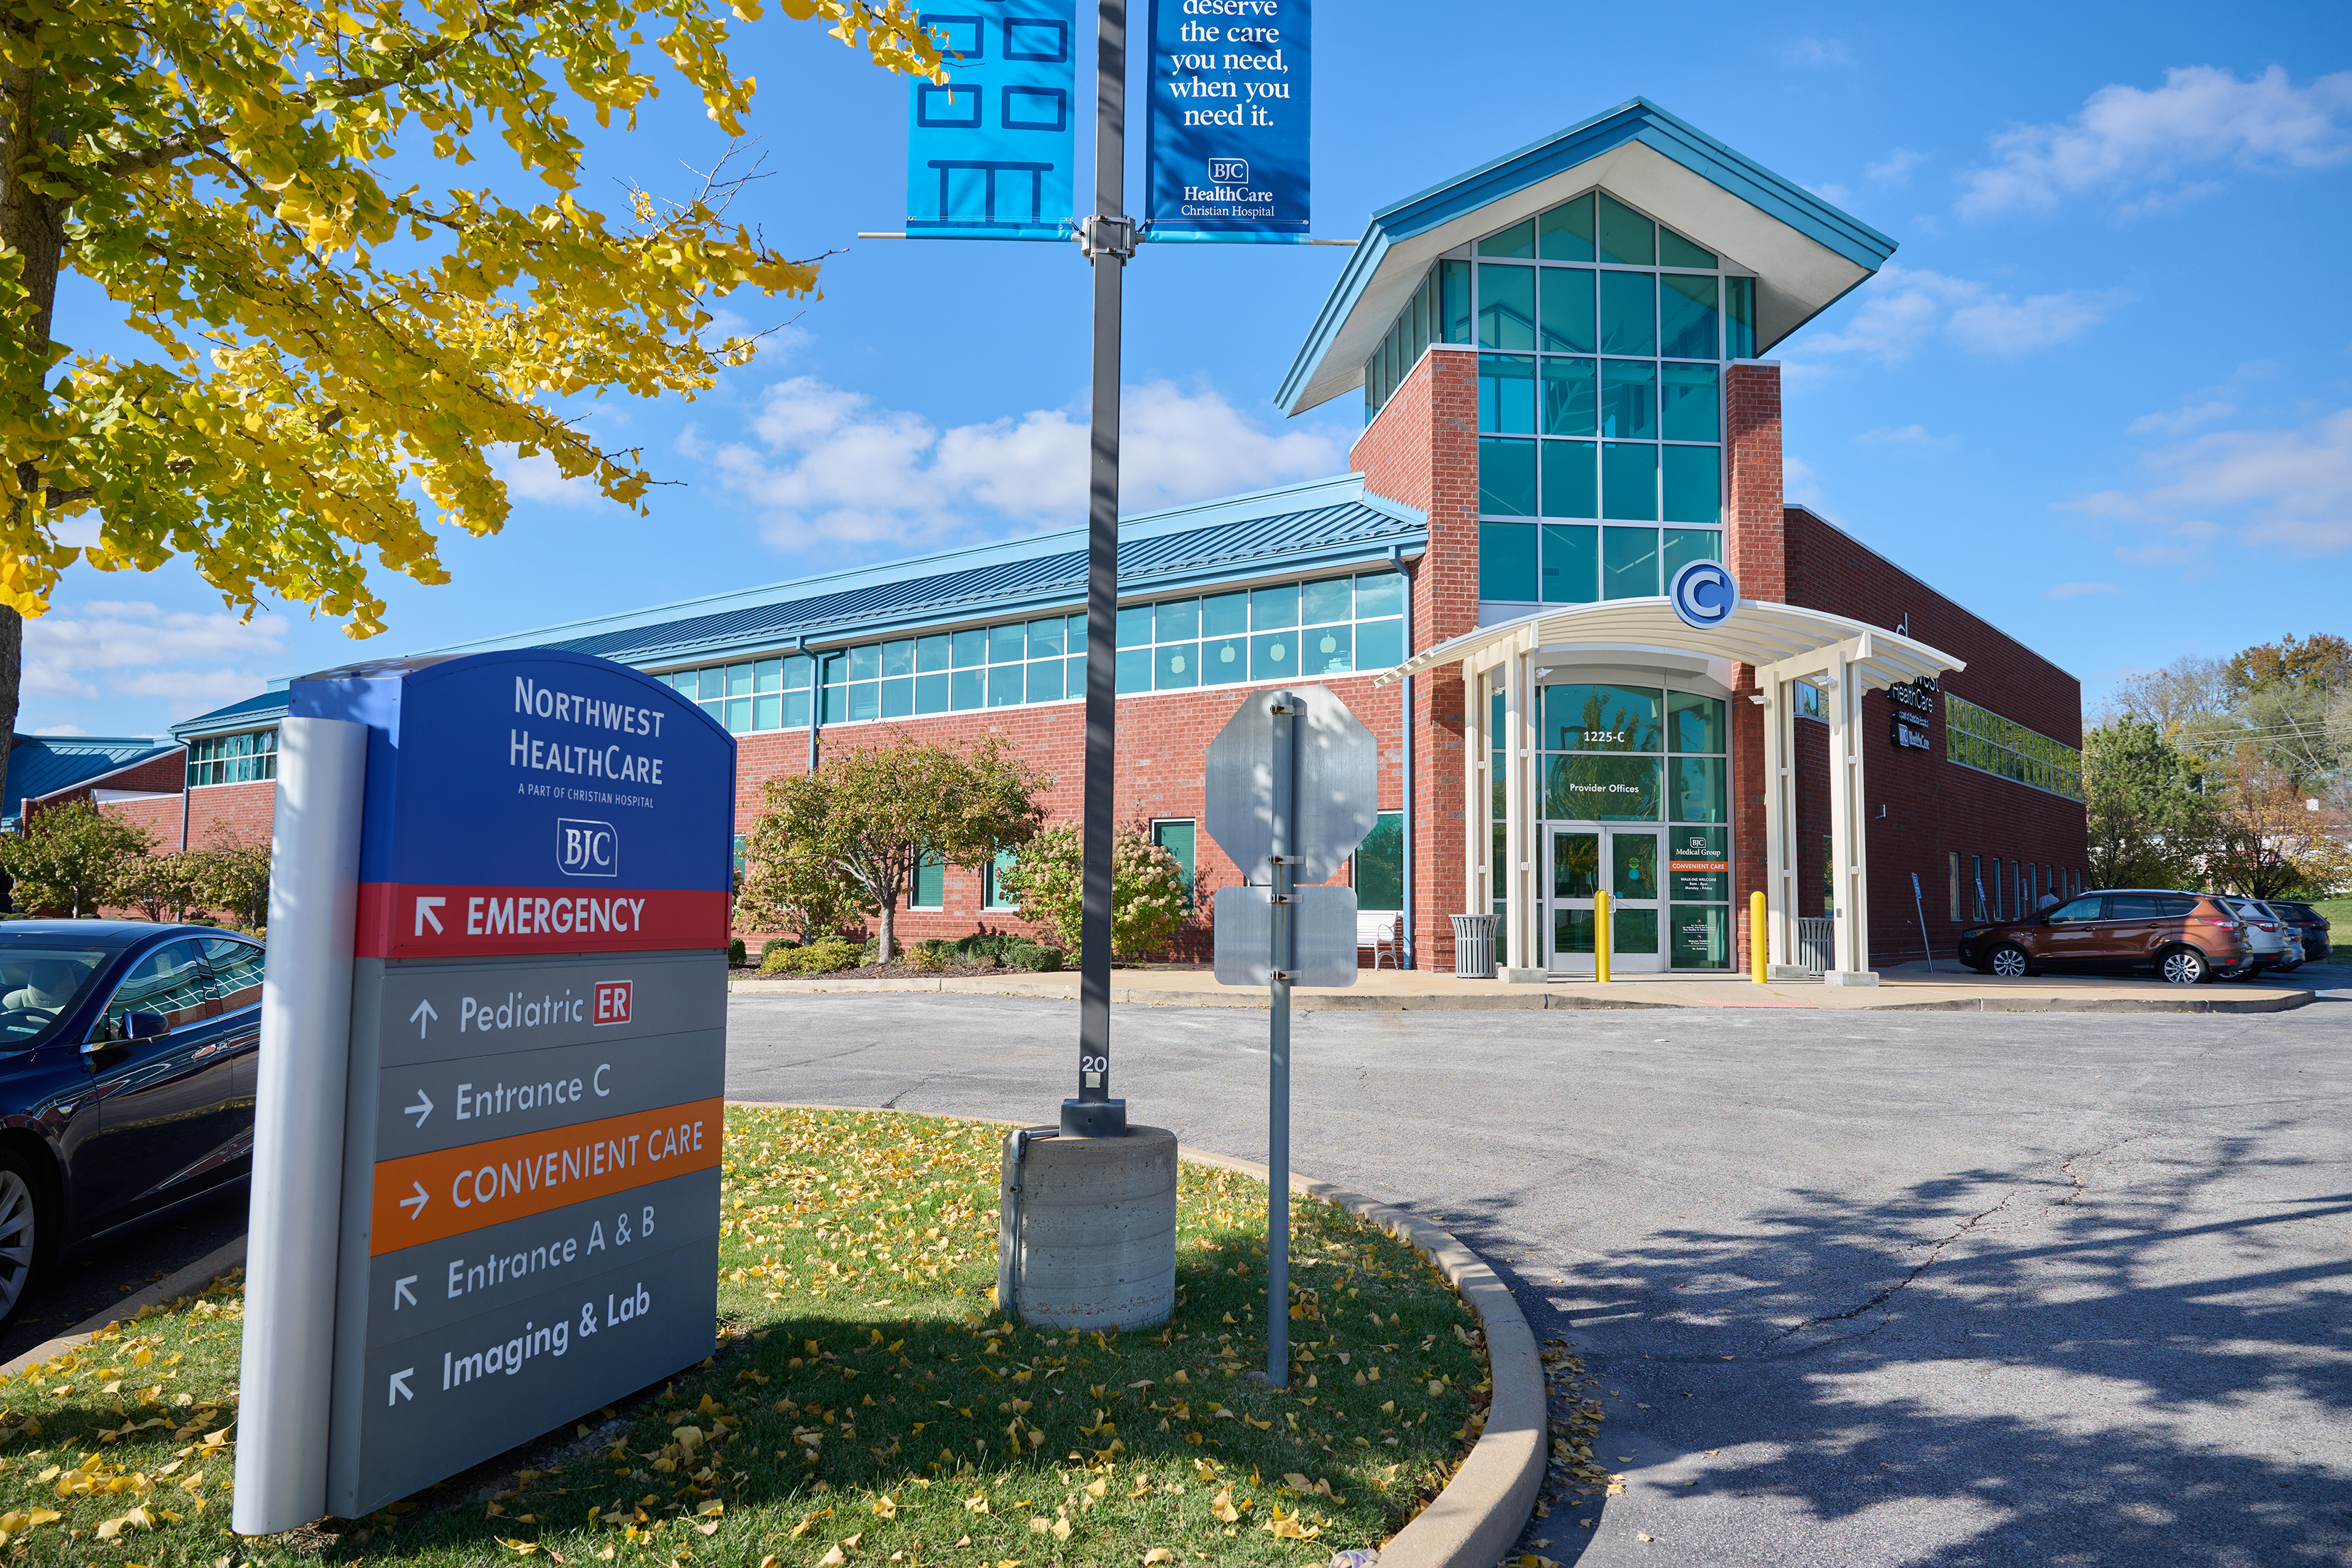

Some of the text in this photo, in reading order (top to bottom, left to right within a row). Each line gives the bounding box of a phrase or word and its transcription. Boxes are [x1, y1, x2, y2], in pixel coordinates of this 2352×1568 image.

[1183, 0, 1277, 16] deserve
[1180, 20, 1279, 43] the care
[1170, 49, 1289, 76] you need,
[1168, 76, 1290, 103] when you
[1184, 103, 1274, 126] need it.
[1214, 163, 1244, 180] BJC
[1183, 186, 1273, 202] HealthCare
[1181, 204, 1274, 219] Christian Hospital
[1683, 571, 1721, 617] C
[1892, 683, 1933, 713] HealthCare
[1584, 731, 1625, 742] 1225-C
[518, 783, 654, 808] A PART OF CHRISTIAN HOSPITAL
[1569, 783, 1639, 793] Provider Offices
[564, 828, 611, 870] BJC
[467, 897, 646, 935] EMERGENCY
[460, 988, 626, 1032] Pediatric ER
[1082, 1056, 1108, 1073] 20
[456, 1063, 611, 1120] Entrance C
[452, 1120, 703, 1208] CONVENIENT CARE
[448, 1205, 655, 1299] Entrance A & B
[443, 1282, 650, 1391] Imaging & Lab
